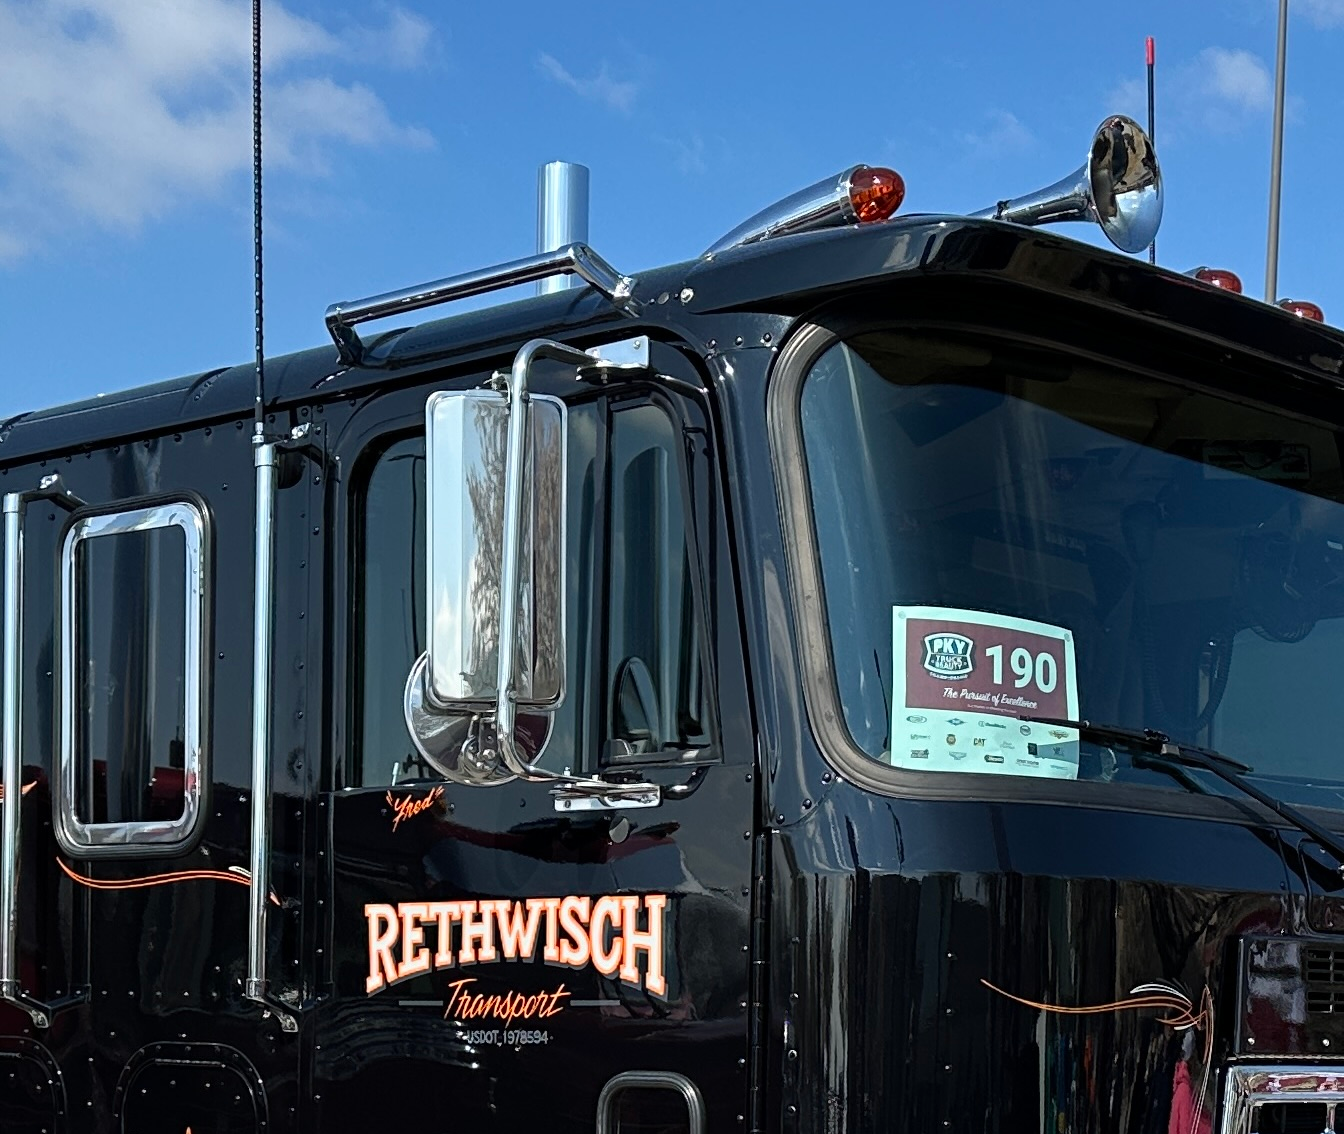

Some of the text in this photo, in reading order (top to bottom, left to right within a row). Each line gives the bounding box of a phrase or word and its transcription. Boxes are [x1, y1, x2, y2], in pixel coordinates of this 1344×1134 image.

[933, 638, 966, 655] PKY
[985, 645, 1058, 694] 190
[943, 687, 958, 699] The
[959, 688, 992, 701] Pursuit
[991, 693, 1001, 706] of
[364, 894, 668, 998] RETHWISCH
[443, 978, 572, 1028] Transport
[467, 1029, 549, 1045] USDOT 1978594
